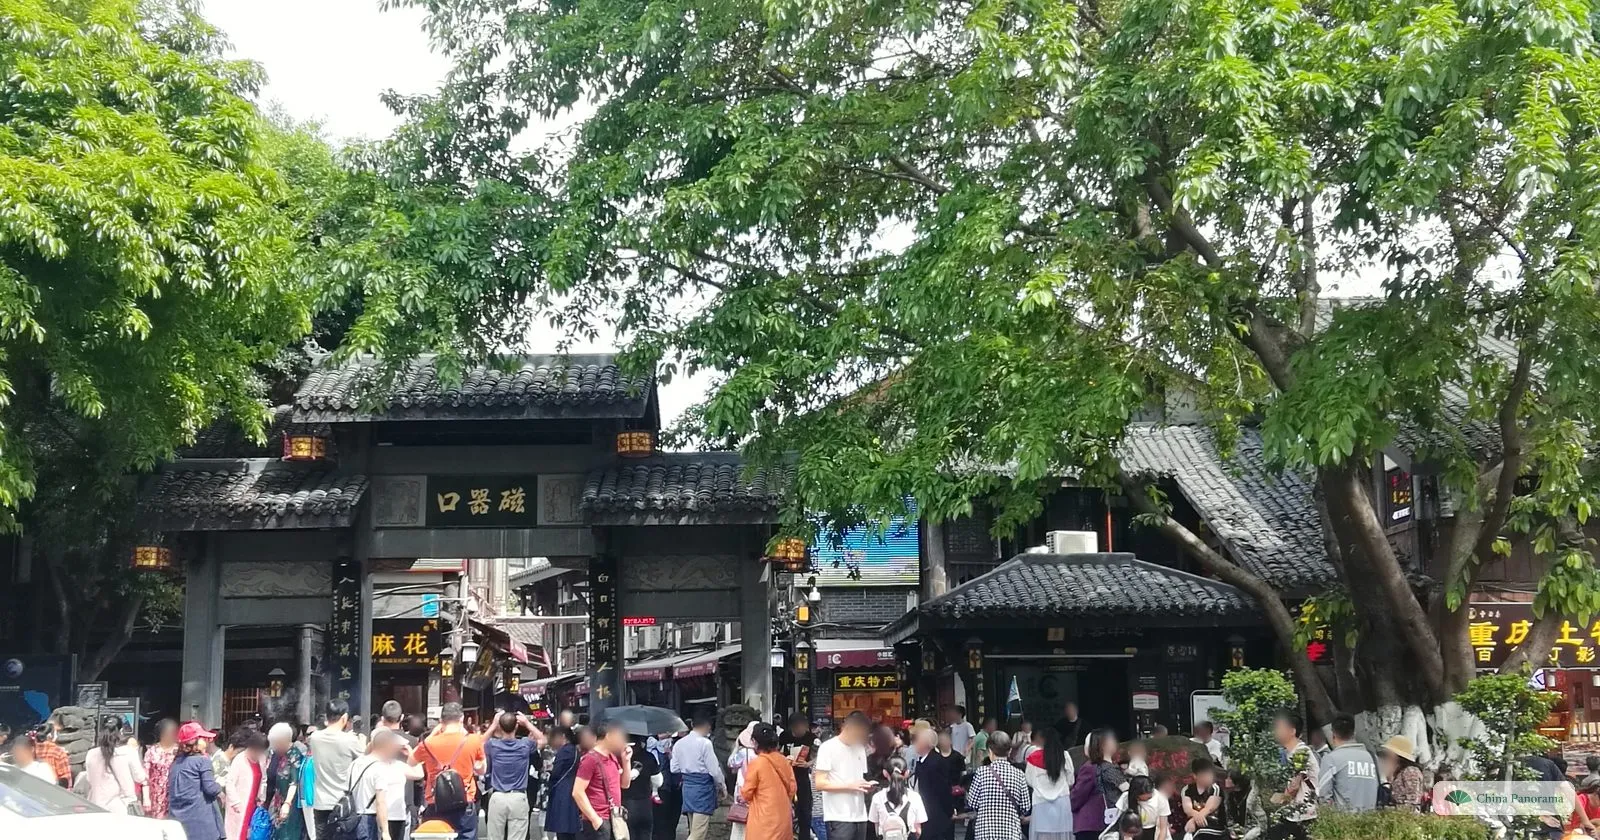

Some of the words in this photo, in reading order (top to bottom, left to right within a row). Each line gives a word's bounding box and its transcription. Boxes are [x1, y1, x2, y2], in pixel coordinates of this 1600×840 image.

[372, 633, 428, 656] 麻花
[838, 675, 896, 688] 重庆特产
